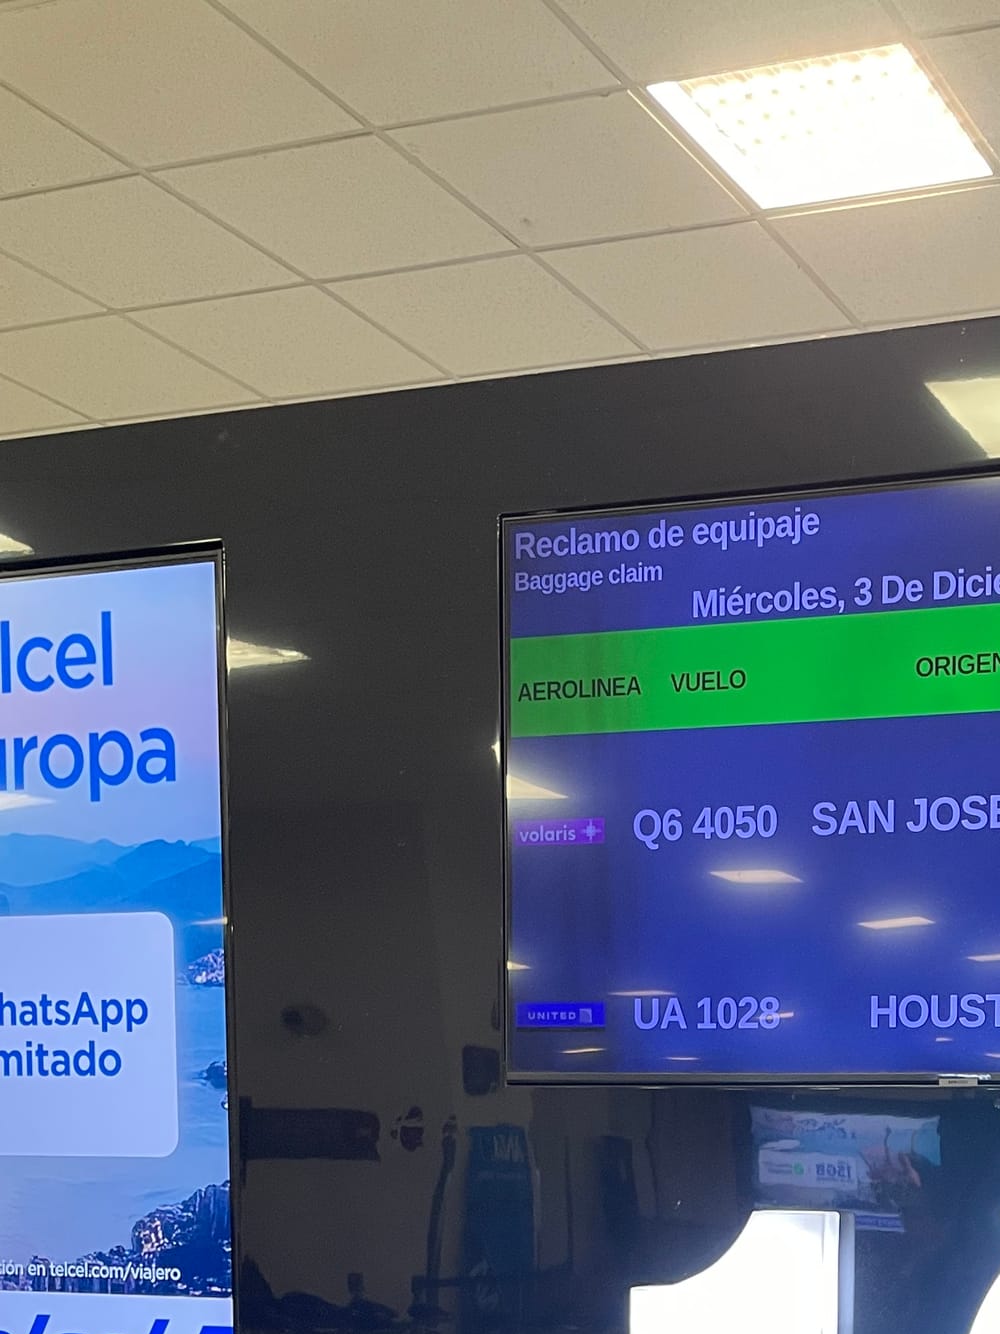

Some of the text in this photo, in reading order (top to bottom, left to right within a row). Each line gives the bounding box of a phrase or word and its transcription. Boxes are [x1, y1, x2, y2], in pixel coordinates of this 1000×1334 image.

[514, 507, 820, 560] Reclamo de equipaje
[514, 562, 663, 594] Baggage claim
[692, 581, 845, 619] Miércoles,
[854, 576, 873, 606] 3
[881, 574, 923, 604] De
[518, 676, 641, 702] AEROLINEA
[671, 669, 747, 693] VUELO
[0, 727, 176, 802] ropa
[519, 823, 577, 844] volaris
[633, 808, 683, 850] Q6
[692, 804, 778, 840] 4050
[812, 799, 895, 836] SAN
[527, 1009, 577, 1021] UNITED
[633, 996, 687, 1030] UA
[696, 995, 781, 1030] 1028
[0, 1259, 181, 1285] ión en telcel.com/viajero
